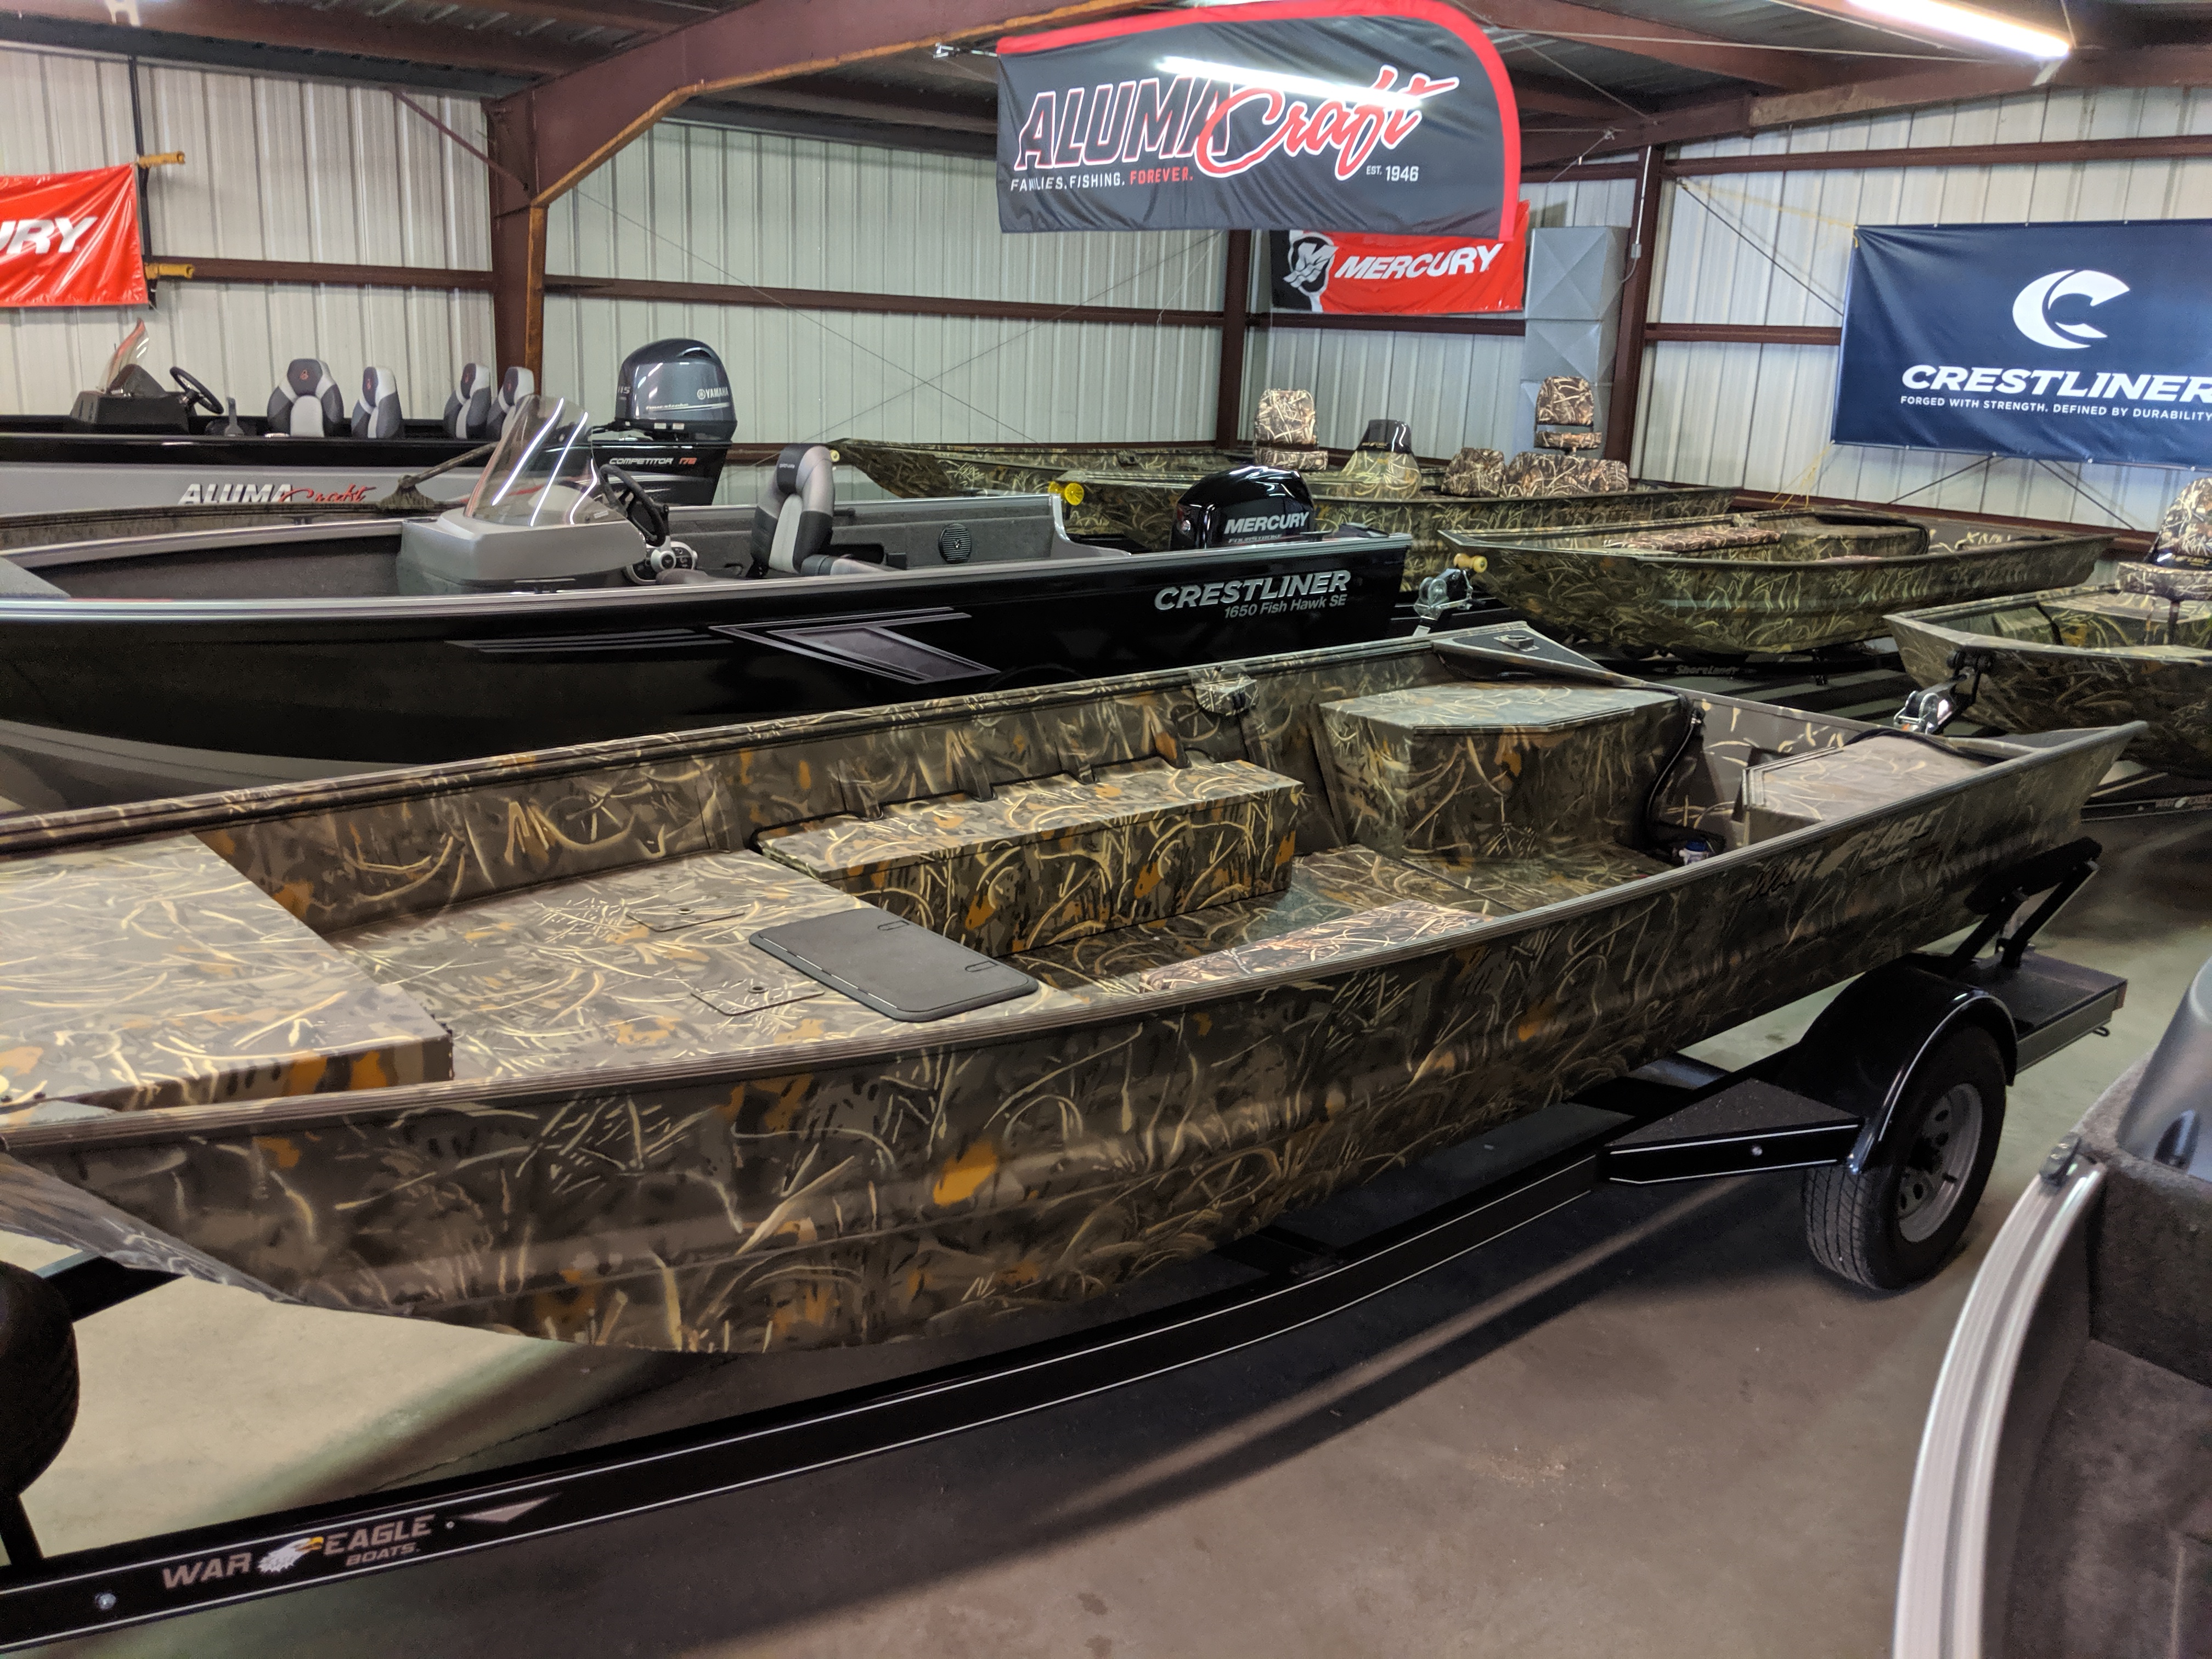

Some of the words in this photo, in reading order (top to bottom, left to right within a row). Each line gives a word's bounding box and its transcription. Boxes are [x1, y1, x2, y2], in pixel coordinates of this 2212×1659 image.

[1070, 172, 1125, 188] FISHING.
[1130, 166, 1193, 185] FOREVER.
[1366, 165, 1383, 176] EST.
[1385, 166, 1419, 182] 1946
[1334, 244, 1504, 280] MERCURY
[706, 386, 729, 399] YAMAHA
[1902, 364, 2212, 403] CRESTLINER
[1900, 396, 1945, 406] FORGED
[1949, 398, 1979, 408] WITH
[1983, 400, 2049, 412] STRENGTH.
[2053, 404, 2107, 416] DEFINED
[2112, 407, 2129, 416] BY
[609, 457, 674, 465] COMPETITOR
[1223, 511, 1310, 535] MERCURY
[1154, 569, 1351, 611] CRESTLINER
[1224, 603, 1257, 619] 1650
[1260, 601, 1288, 615] Fish
[1290, 597, 1327, 612] Hawk
[1329, 594, 1348, 607] SE
[163, 1552, 253, 1589] WAR
[323, 1514, 435, 1555] EAGLE
[345, 1543, 417, 1567] BOATS
